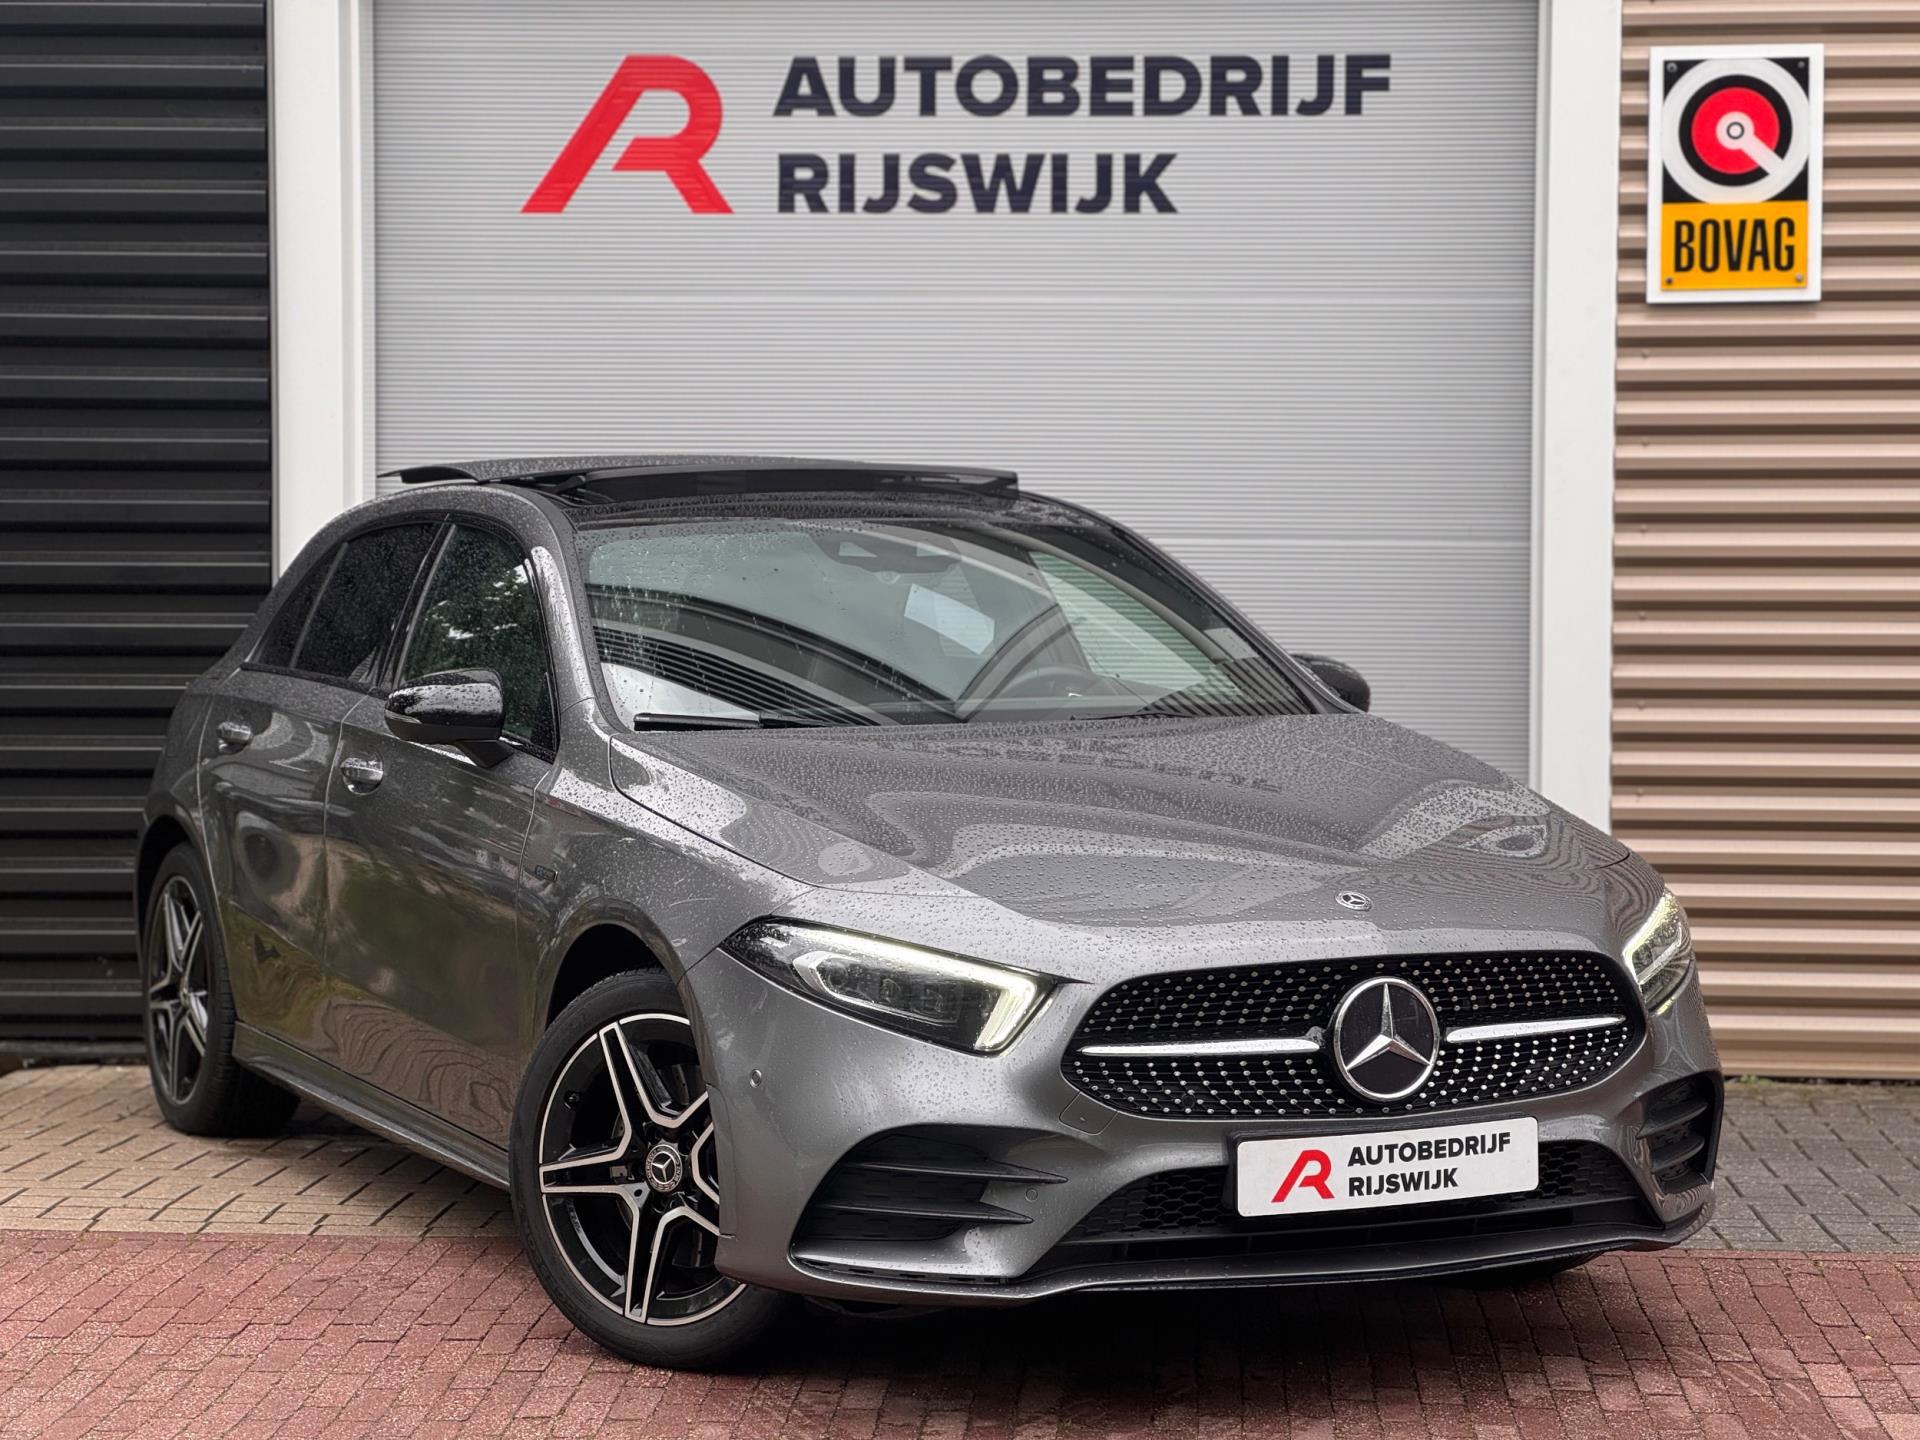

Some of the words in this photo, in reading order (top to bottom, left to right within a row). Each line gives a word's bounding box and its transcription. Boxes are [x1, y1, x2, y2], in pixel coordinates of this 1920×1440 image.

[773, 54, 1391, 117] AUTOBEDRIJF
[778, 153, 1177, 214] RIJSWIJK
[1674, 217, 1796, 273] BOVAG
[1347, 1131, 1511, 1167] AUTOBEDRIJF
[1348, 1167, 1459, 1198] RIJSWIJK
